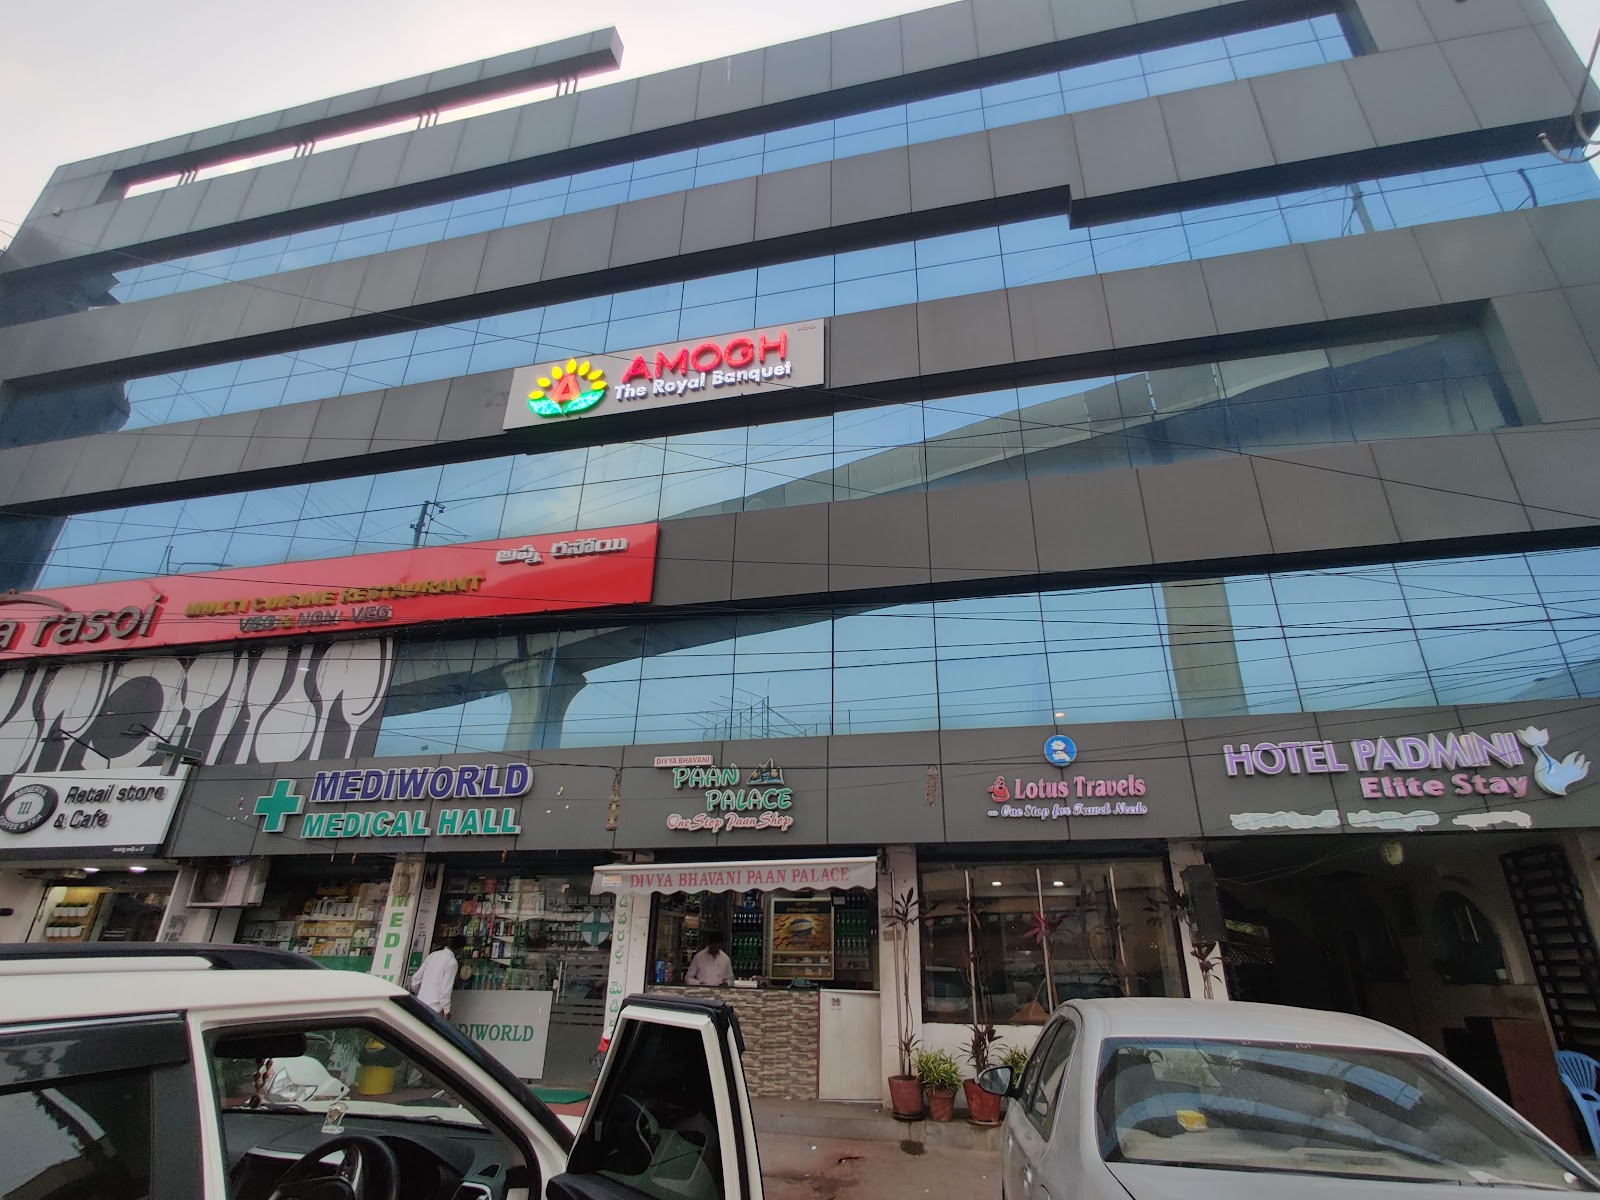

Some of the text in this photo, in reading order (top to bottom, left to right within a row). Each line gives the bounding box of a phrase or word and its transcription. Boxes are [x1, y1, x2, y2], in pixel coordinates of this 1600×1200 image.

[621, 330, 787, 384] AMOGH
[614, 361, 792, 402] The Royal Banquet
[185, 575, 486, 618] MULTI CUISINE RESTAURANT
[31, 593, 168, 648] rasoi
[239, 615, 277, 633] VEG
[297, 609, 341, 628] NON
[352, 605, 393, 623] VEG
[656, 756, 711, 765] DIVYA BHAVANI
[1223, 731, 1524, 777] HOTEL PADMINI
[310, 763, 533, 803] MEDIWORLD
[673, 763, 741, 789] PAAN
[1014, 774, 1146, 800] Lotus Travels
[1360, 773, 1529, 799] Elite Stay
[14, 785, 48, 798] MINERVA
[65, 784, 168, 804] Retail store
[705, 788, 793, 811] PALACE
[28, 814, 43, 826] TEA
[54, 809, 111, 829] & Cafe
[301, 807, 521, 838] MEDICAL HALL
[667, 811, 794, 833] One Stop Paan Shop
[1001, 804, 1024, 817] One
[1024, 804, 1050, 820] Stop
[1051, 803, 1071, 819] for
[1072, 802, 1111, 817] Travel
[1112, 801, 1148, 816] Needs
[630, 872, 672, 888] DIVYA
[678, 870, 741, 886] BHAVANI
[746, 869, 786, 884] PAAN
[791, 867, 849, 883] PALACE
[453, 1023, 534, 1042] DIWORLD
